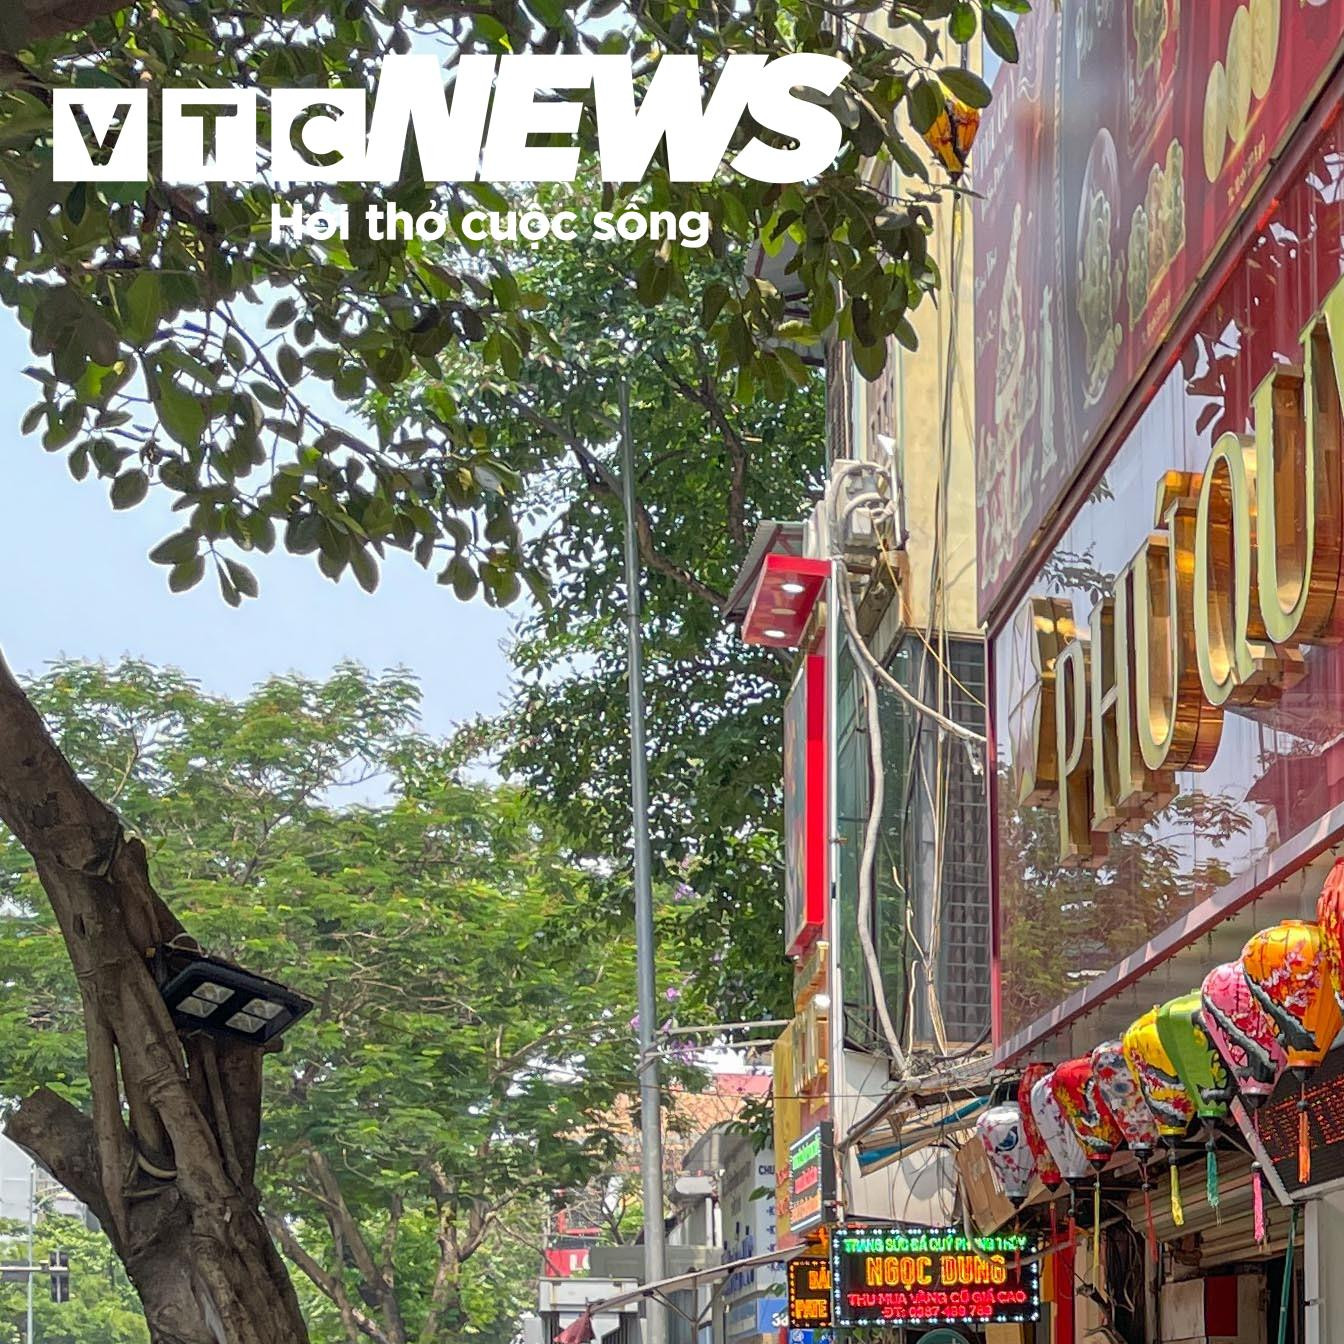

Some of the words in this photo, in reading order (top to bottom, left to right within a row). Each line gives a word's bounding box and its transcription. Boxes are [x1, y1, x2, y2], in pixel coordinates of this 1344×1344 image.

[1057, 470, 1205, 868] PHÚ
[866, 1256, 932, 1291] NGỌC
[848, 1293, 876, 1307] THU
[877, 1292, 907, 1306] MUA
[997, 1290, 1027, 1304] CAO
